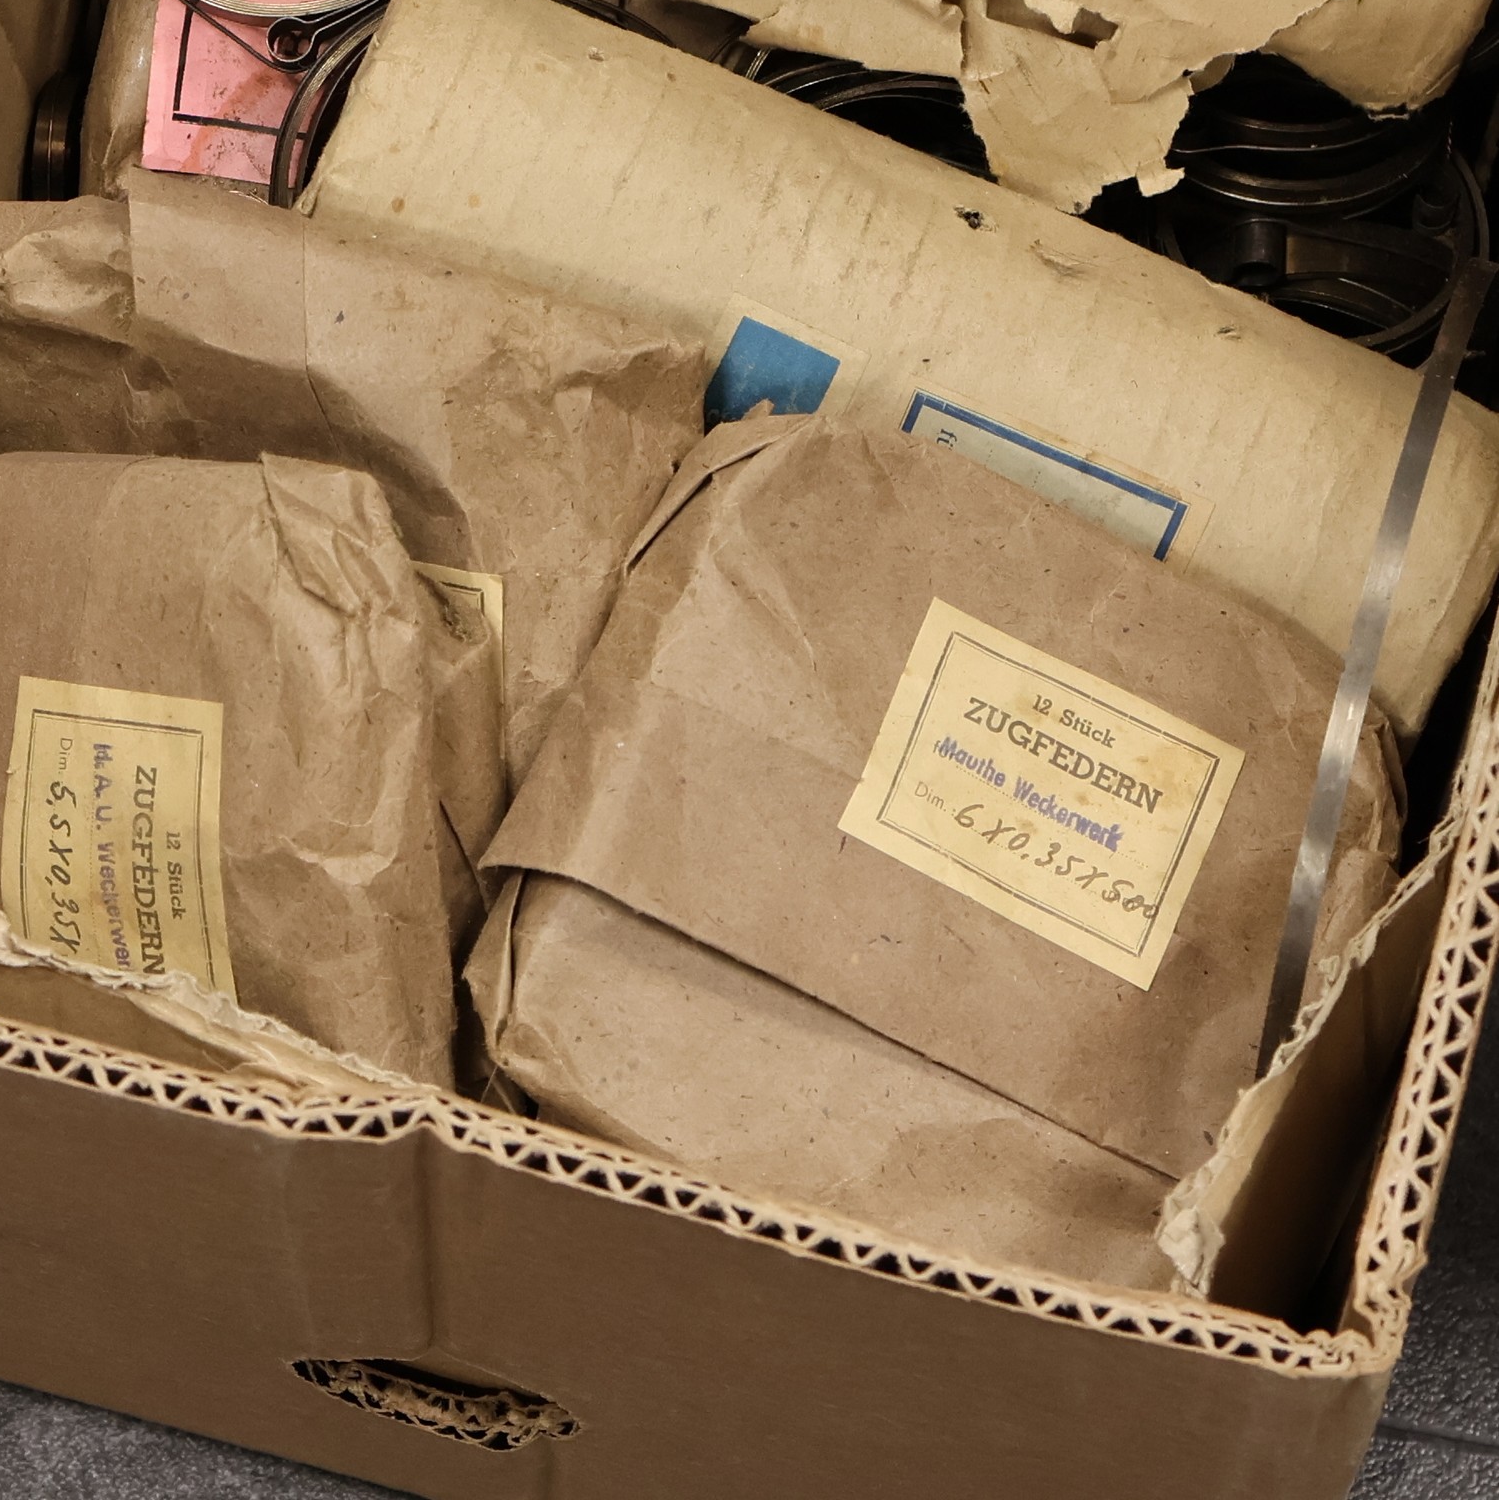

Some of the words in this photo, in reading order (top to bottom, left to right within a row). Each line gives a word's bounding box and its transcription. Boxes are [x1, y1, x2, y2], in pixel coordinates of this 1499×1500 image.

[1032, 694, 1053, 716] 12
[1059, 708, 1116, 748] Stück
[58, 737, 74, 775] Dim.
[964, 697, 1164, 814] ZUGFEDERN
[166, 831, 181, 850] 12
[1013, 776, 1125, 852] Weckerwerk
[132, 765, 166, 975] ZUGFEDERN
[167, 861, 187, 920] Stück
[97, 841, 132, 970] Weckerwer
